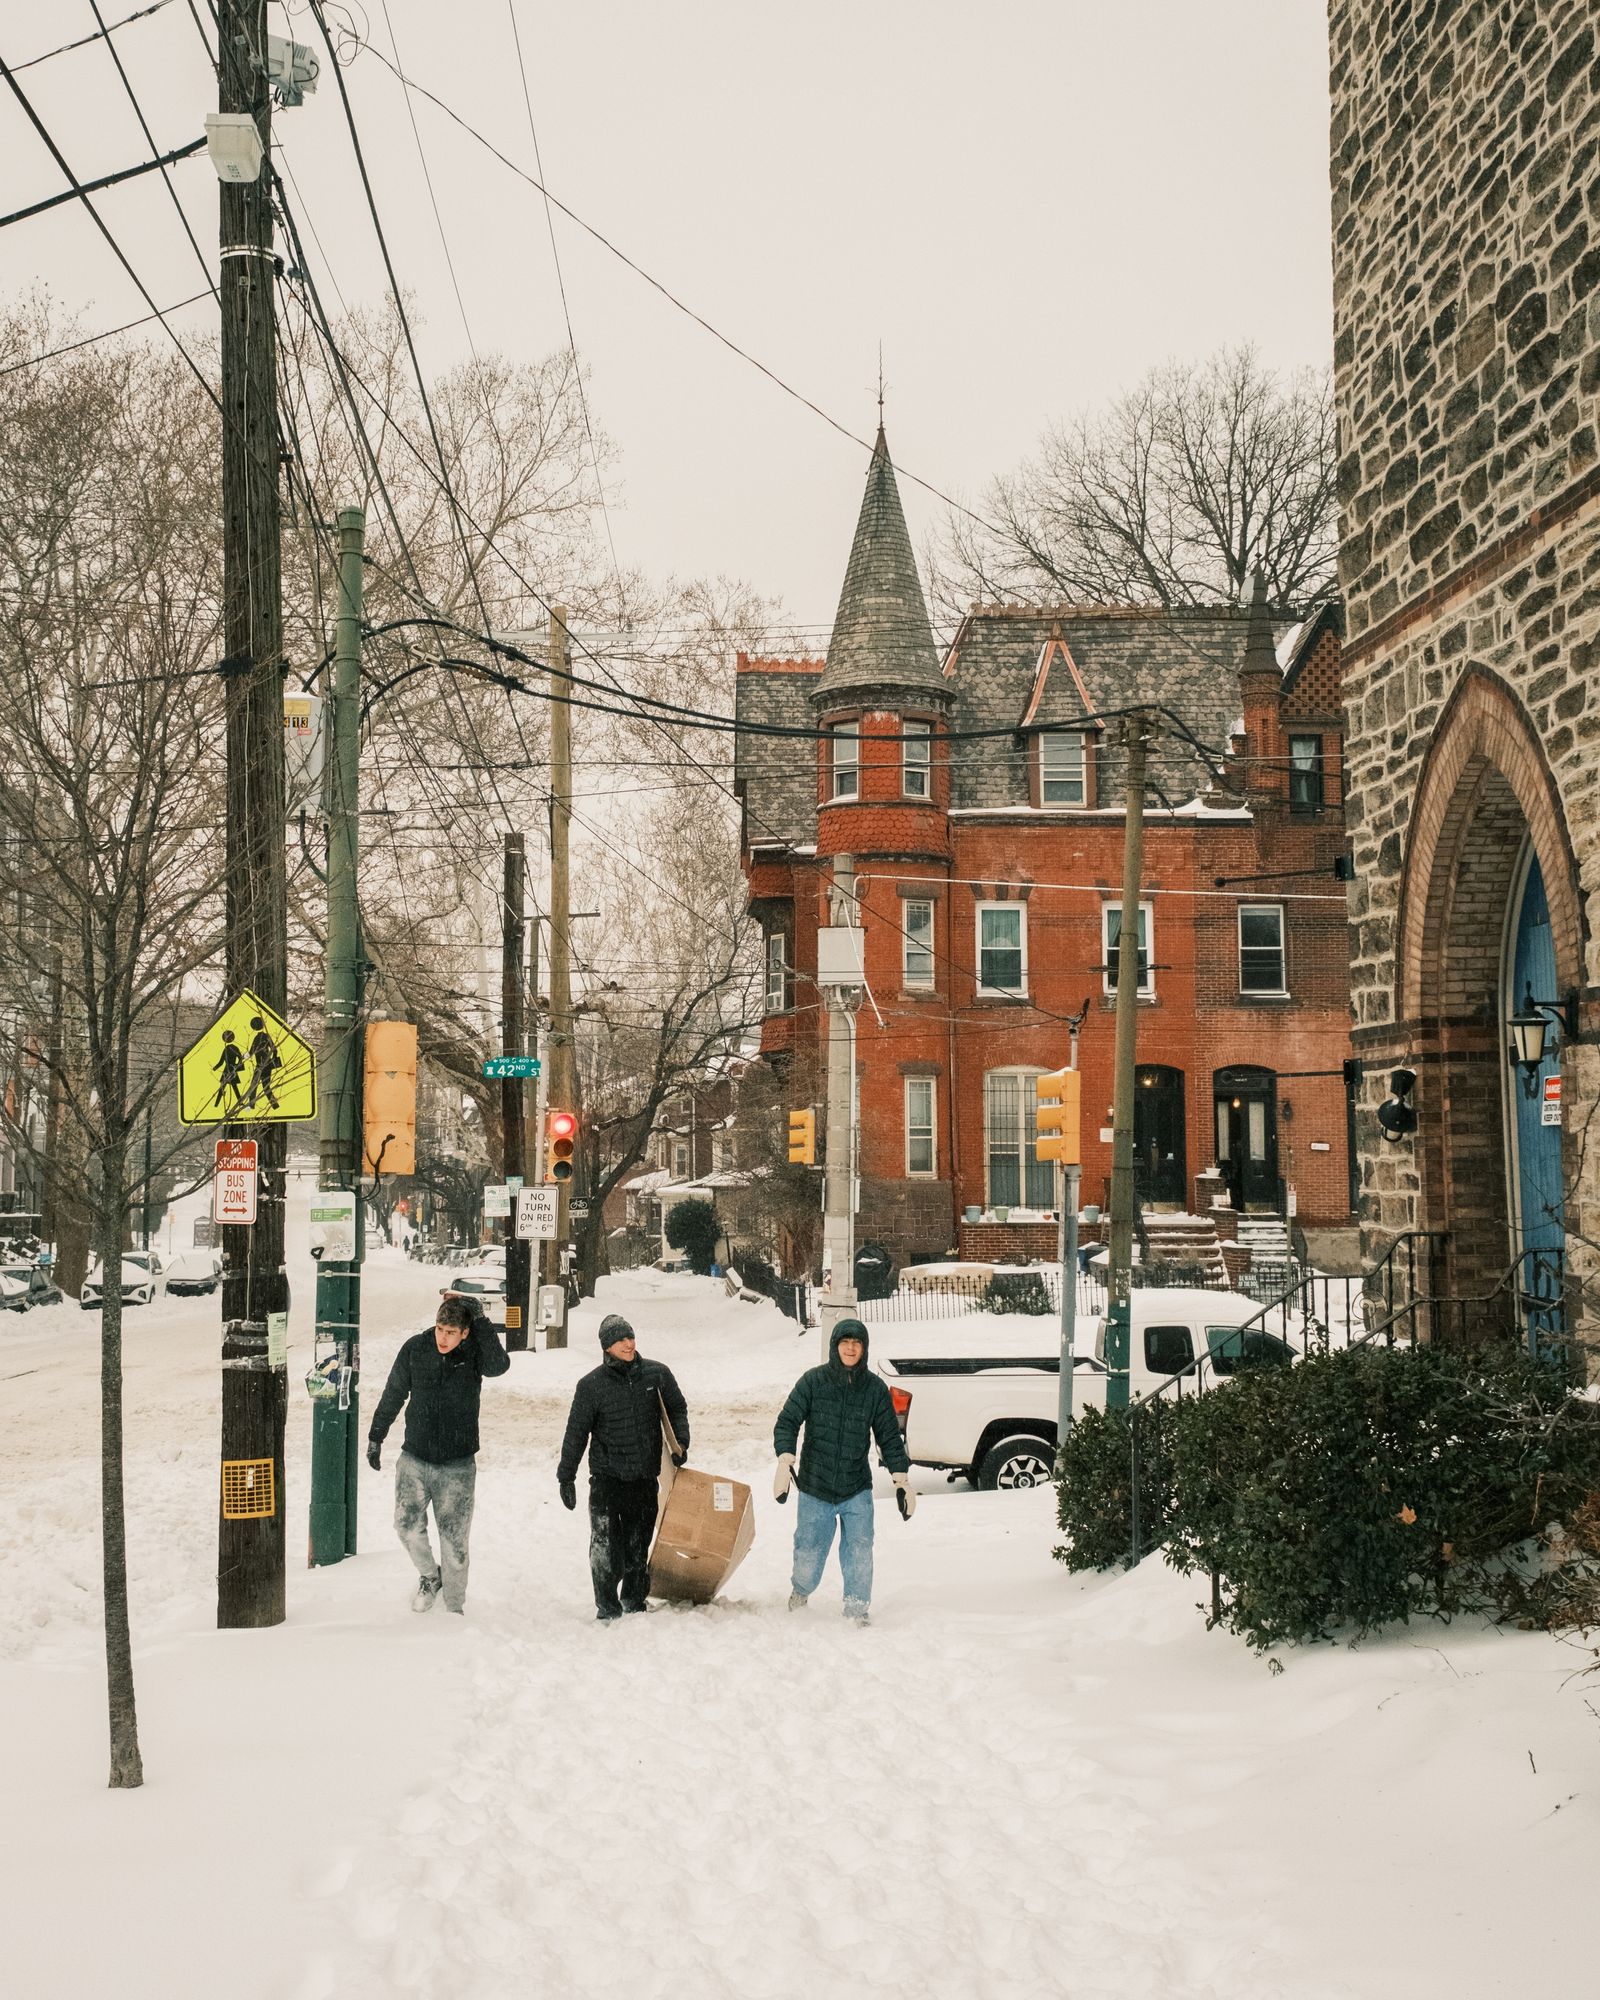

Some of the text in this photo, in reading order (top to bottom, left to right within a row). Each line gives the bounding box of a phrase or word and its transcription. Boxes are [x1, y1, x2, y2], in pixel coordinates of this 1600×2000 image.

[497, 1064, 526, 1076] 42ND
[1545, 1084, 1561, 1094] DANGE
[231, 1142, 242, 1155] NO
[218, 1157, 255, 1169] STOPPING
[227, 1174, 245, 1187] BUS
[223, 1190, 247, 1204] ZONE
[530, 1193, 545, 1201] NO
[525, 1203, 551, 1211] TURN
[520, 1213, 554, 1222] ON RED
